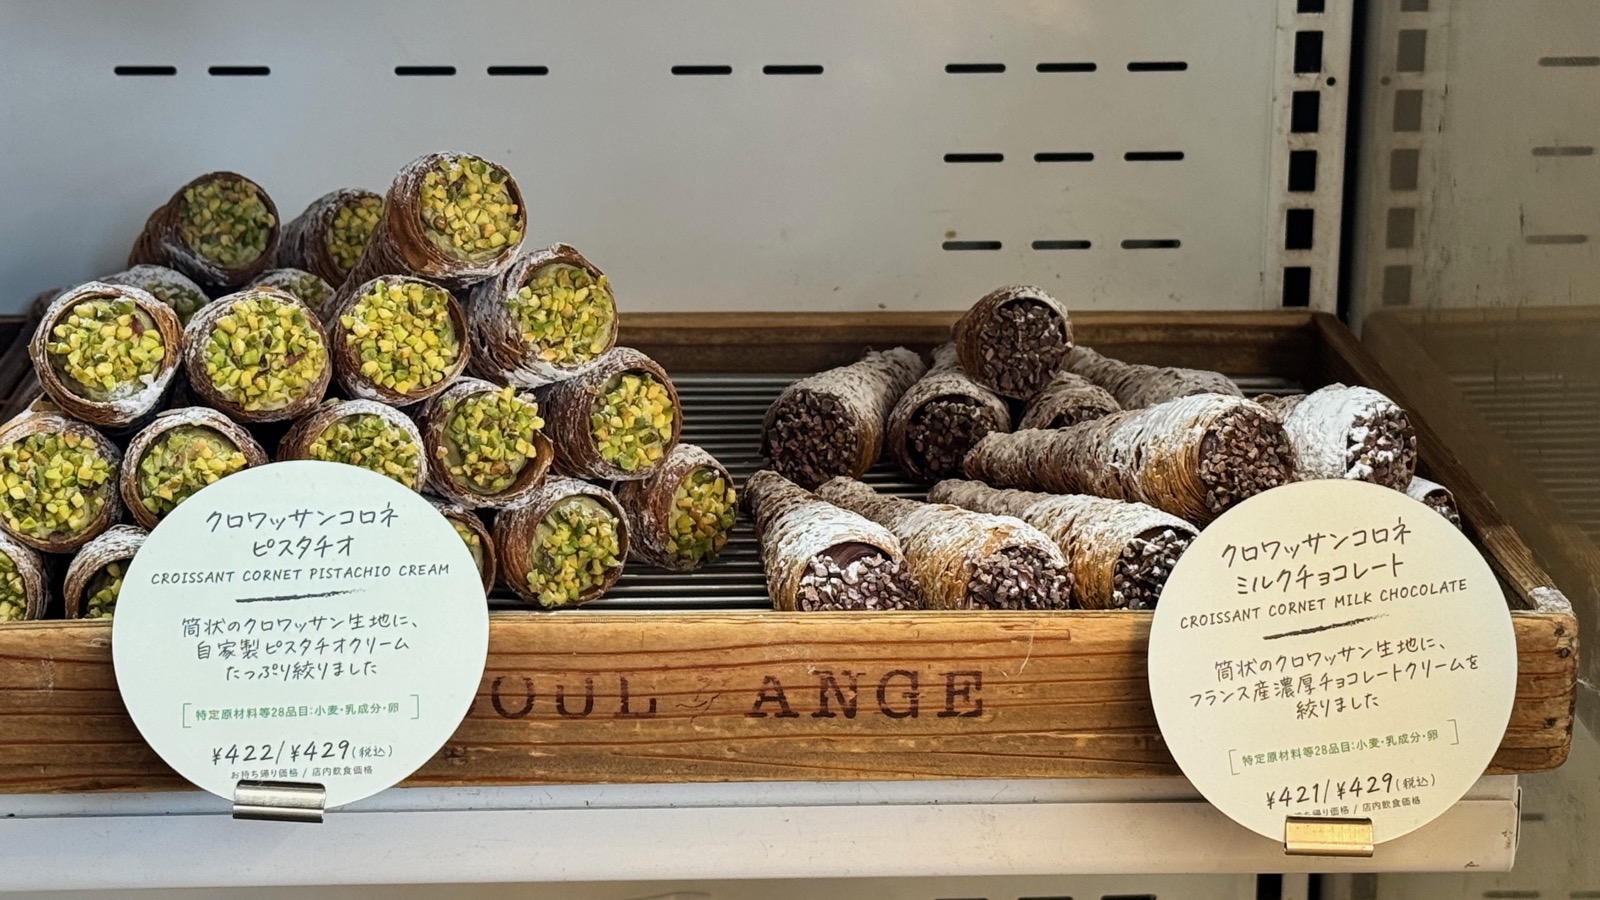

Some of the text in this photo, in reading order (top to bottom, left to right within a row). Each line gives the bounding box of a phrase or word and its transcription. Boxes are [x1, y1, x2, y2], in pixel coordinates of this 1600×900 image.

[205, 502, 399, 532] クロワッサンコロネ
[252, 535, 355, 559] ピスタチオ
[1221, 517, 1412, 568] クロワッサンコロネ
[151, 563, 449, 585] CROISSANT CORNET PISTACHIO CREAM
[1236, 552, 1405, 596] ミルクチョコレート
[1180, 578, 1468, 629] CROISSANT CORNET MILK CHOCOLATE
[181, 613, 418, 638] 筒状のクロワッサン生地に、
[198, 639, 409, 660] 自家製ピスタチオクリーム
[1214, 637, 1446, 682] 筒状のクロワッサン生地に、
[226, 661, 378, 681] たっぷり絞りました
[1190, 654, 1479, 708] フランス産濃厚チョコレートクリームを
[744, 668, 986, 720] ANGE
[1296, 693, 1379, 720] 絞りました
[312, 766, 373, 777] 店内飲食価格
[1362, 796, 1421, 812] 店内飲食価格
